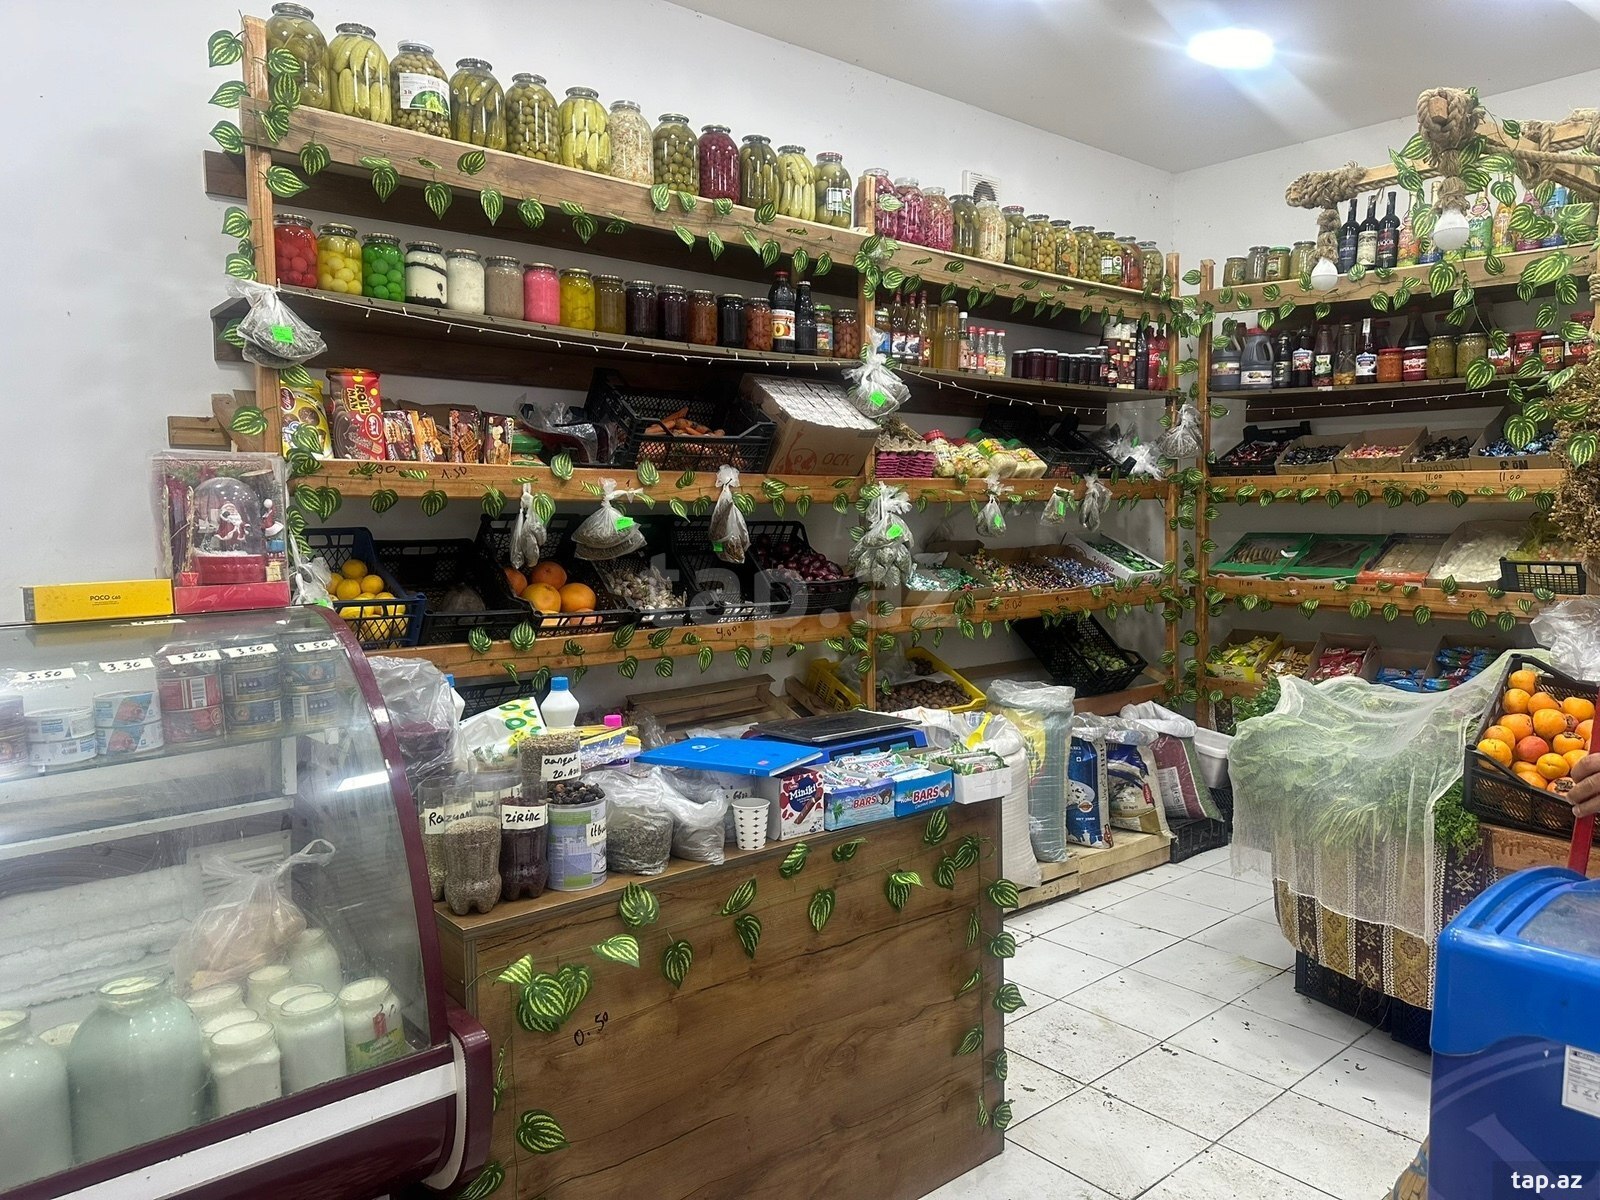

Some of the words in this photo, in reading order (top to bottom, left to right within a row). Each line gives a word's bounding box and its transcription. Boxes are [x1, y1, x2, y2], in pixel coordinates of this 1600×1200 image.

[347, 388, 359, 411] MAN
[355, 384, 370, 415] ROLL
[853, 794, 877, 810] BARS
[912, 785, 940, 804] BARS
[573, 1011, 609, 1047] 0.50
